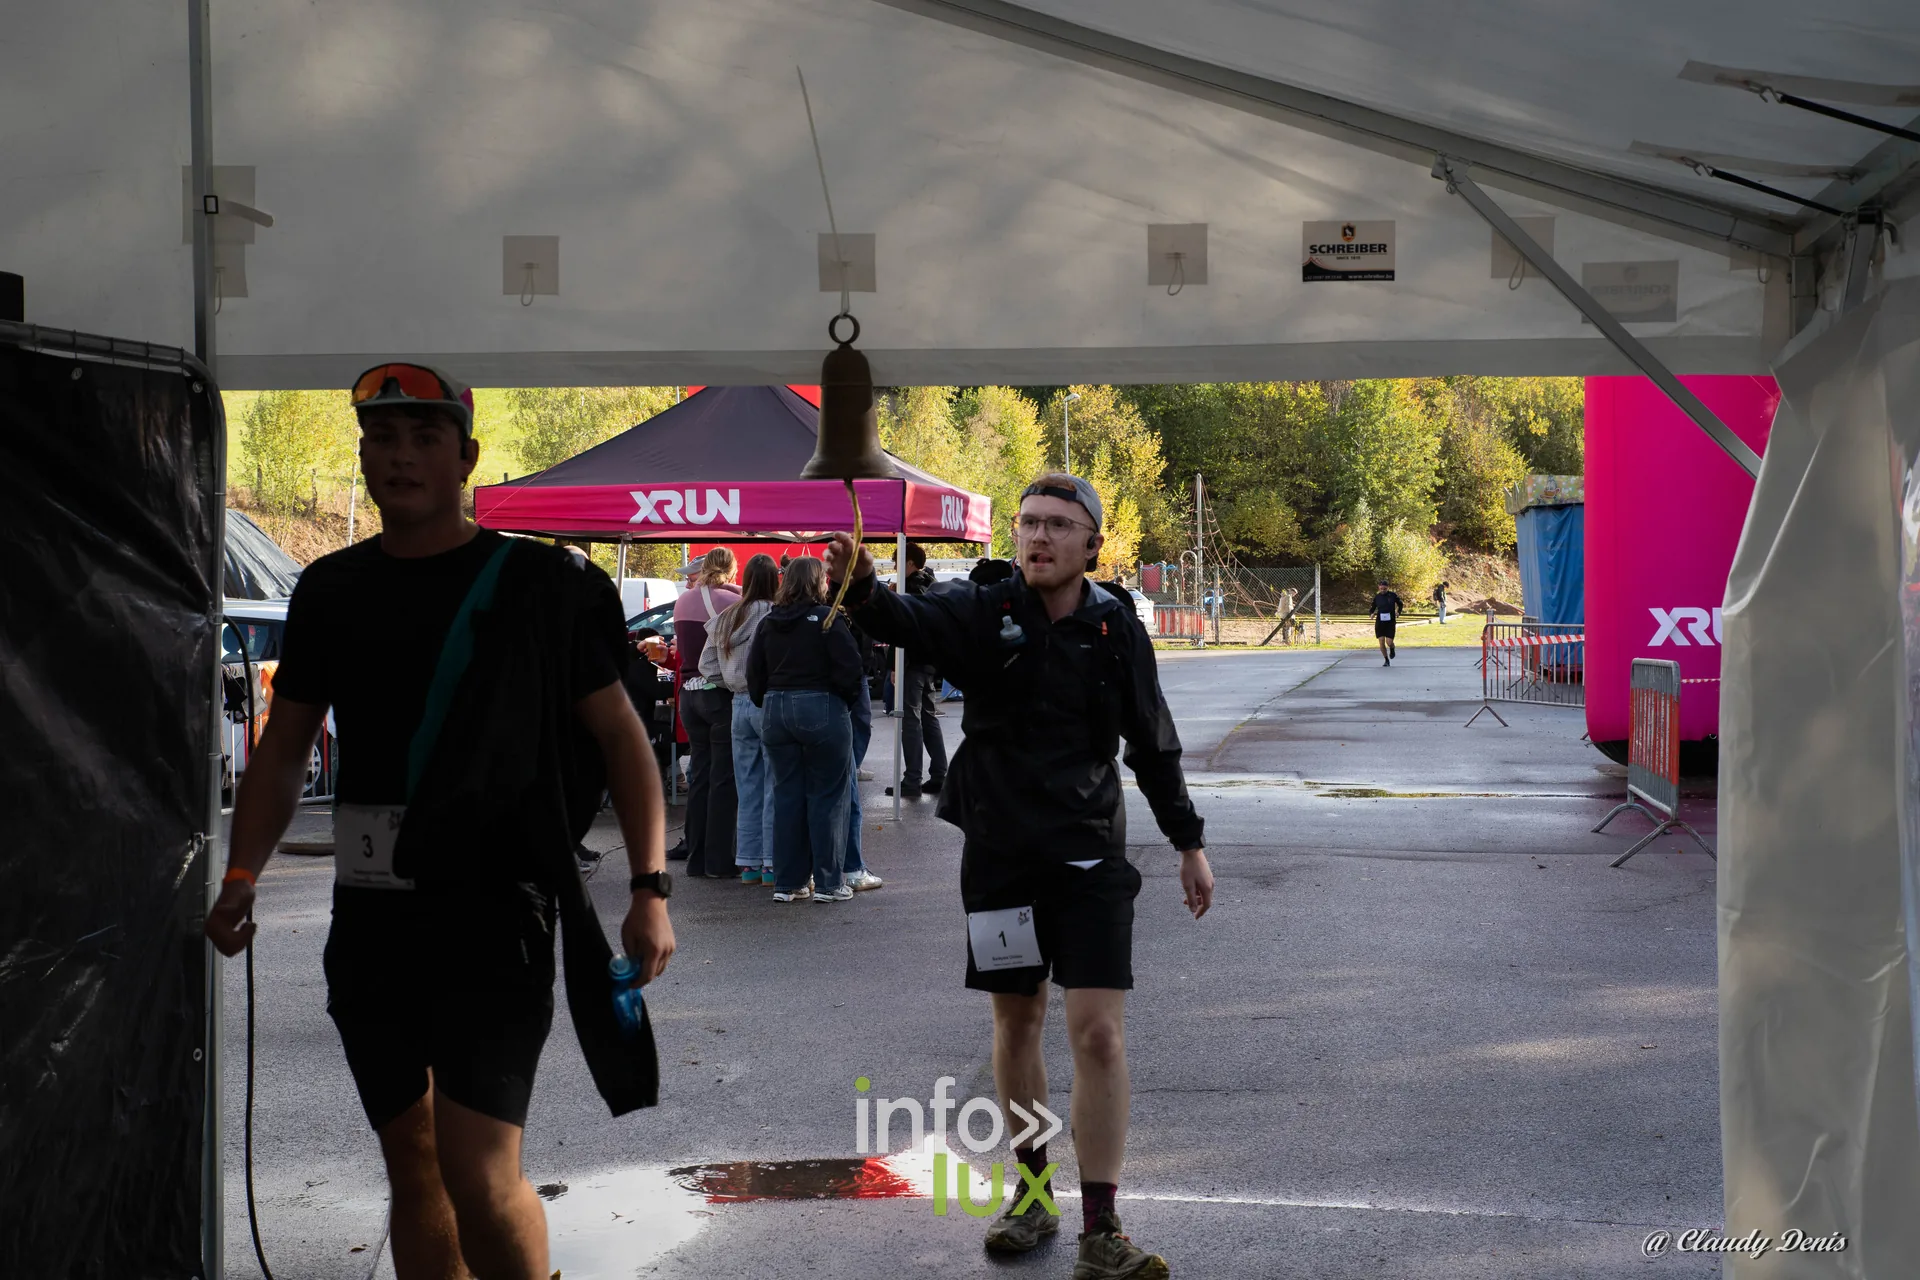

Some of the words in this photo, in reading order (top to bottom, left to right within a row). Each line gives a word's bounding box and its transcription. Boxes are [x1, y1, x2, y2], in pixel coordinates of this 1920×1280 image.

[1309, 243, 1387, 254] SCHREIBER
[628, 489, 740, 525] XRUN
[941, 495, 965, 532] XRUN
[362, 834, 374, 859] 3
[998, 930, 1007, 948] 1
